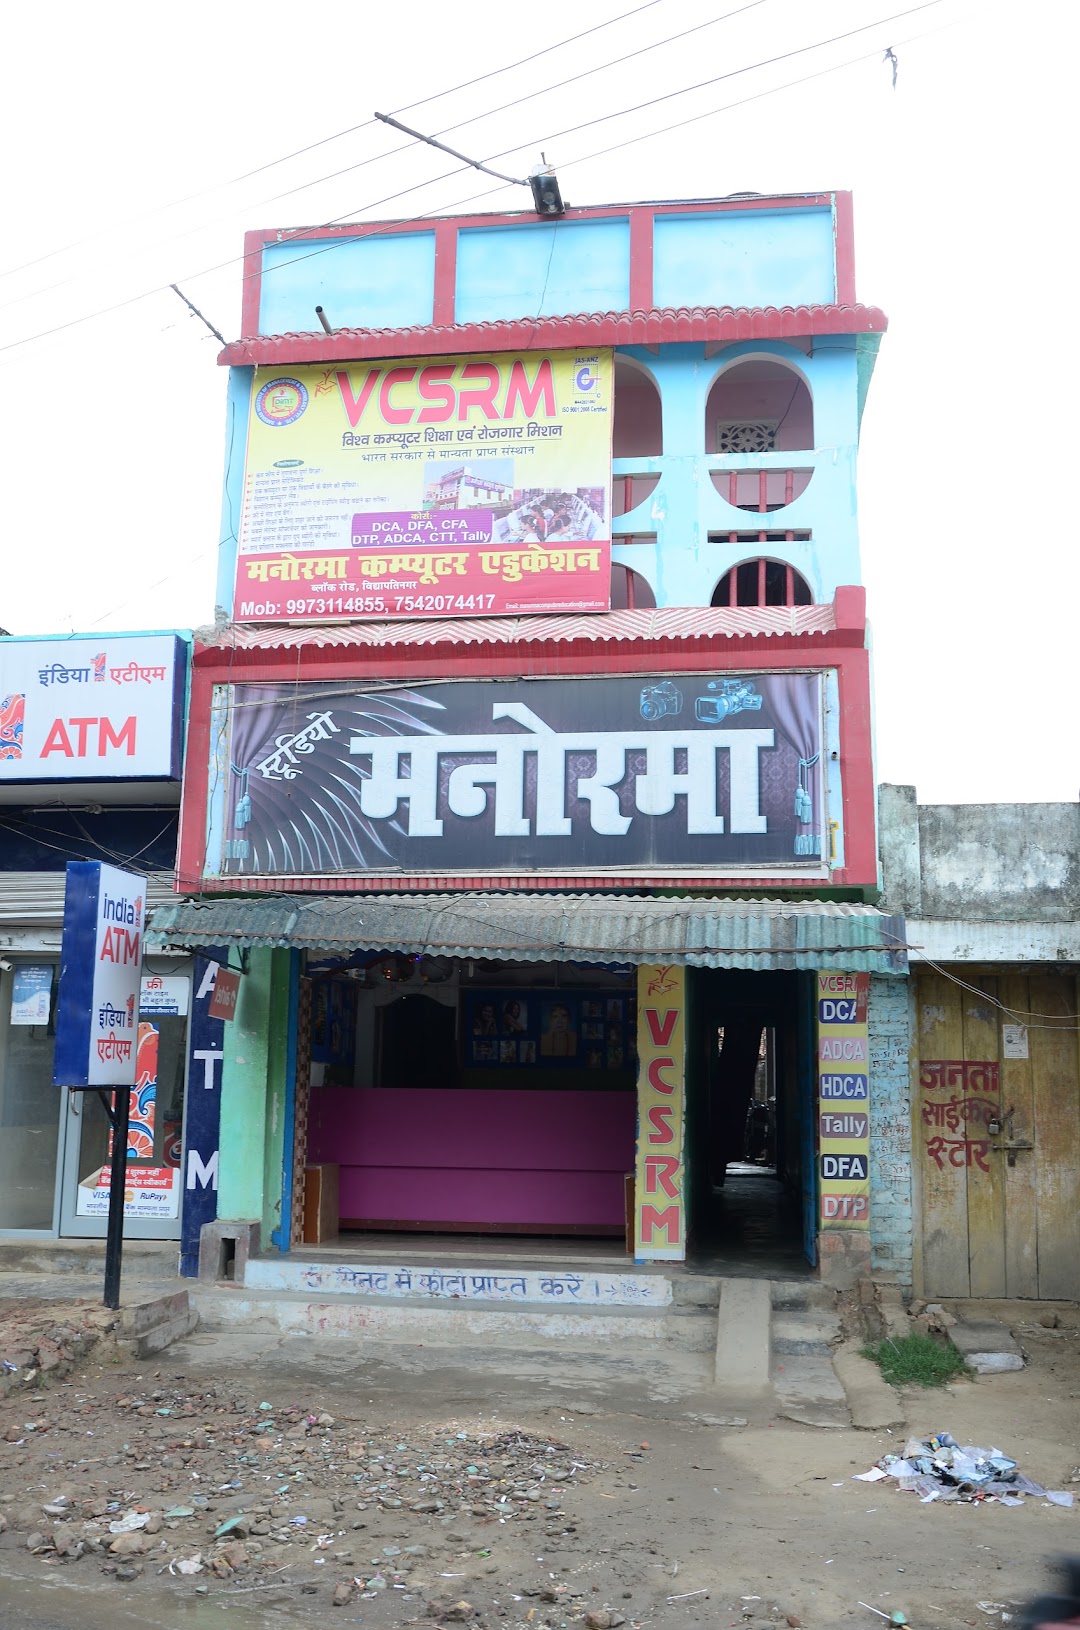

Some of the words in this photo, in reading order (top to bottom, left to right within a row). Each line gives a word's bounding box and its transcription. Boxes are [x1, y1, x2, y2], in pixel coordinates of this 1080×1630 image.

[335, 358, 557, 428] VCSRM
[342, 432, 370, 447] विश्व
[373, 433, 421, 449] कम्प्यूटर
[424, 427, 453, 444] शिक्षा
[457, 425, 476, 442] एवं
[478, 424, 524, 440] रोजगार
[527, 422, 563, 437] मिशन
[362, 453, 386, 462] भारत
[390, 451, 423, 460] सरकार
[427, 448, 435, 458] से
[440, 449, 472, 459] मान्यता
[476, 448, 497, 457] प्राप्त
[501, 445, 535, 456] संस्थान
[352, 535, 380, 545] DTP,
[384, 533, 426, 543] ADCA,
[430, 532, 457, 542] CTT,
[461, 531, 490, 542] Tally
[372, 522, 404, 532] DCA,
[408, 520, 437, 531] DFA,
[442, 520, 468, 529] CFA
[246, 553, 350, 582] मनोरमा
[358, 552, 470, 584] कम्प्यूटर
[478, 544, 601, 582] एडुकेशन
[310, 582, 336, 592] ब्लॉक
[339, 582, 359, 592] रोड,
[362, 578, 417, 591] विद्यापतिनगर
[240, 601, 280, 616] Mob:
[286, 597, 389, 614] 9973114855,
[394, 594, 496, 611] 7542074417
[39, 664, 90, 687] इंडिया
[110, 662, 166, 685] एटीएम
[39, 716, 137, 758] ATM
[350, 702, 774, 836] मनोरमा
[104, 893, 134, 925] india
[100, 926, 140, 967] ATM
[147, 978, 163, 989] फ्री
[99, 1002, 126, 1030] इंडिया
[97, 1032, 132, 1064] एटीएम
[822, 1040, 865, 1061] ADCA
[187, 960, 223, 1190] ATM
[822, 1076, 866, 1097] HDCA
[920, 1060, 999, 1092] जनता
[640, 1008, 682, 1244] VCSRM
[822, 1115, 866, 1137] Tally
[926, 1132, 992, 1172] स्टोर
[823, 1158, 865, 1178] DFA
[140, 1192, 163, 1201] RuPay
[825, 1197, 866, 1217] DTP
[394, 1268, 412, 1290] में
[420, 1269, 467, 1292] फोटो
[470, 1275, 528, 1295] प्राप्त
[538, 1274, 584, 1298] करें
